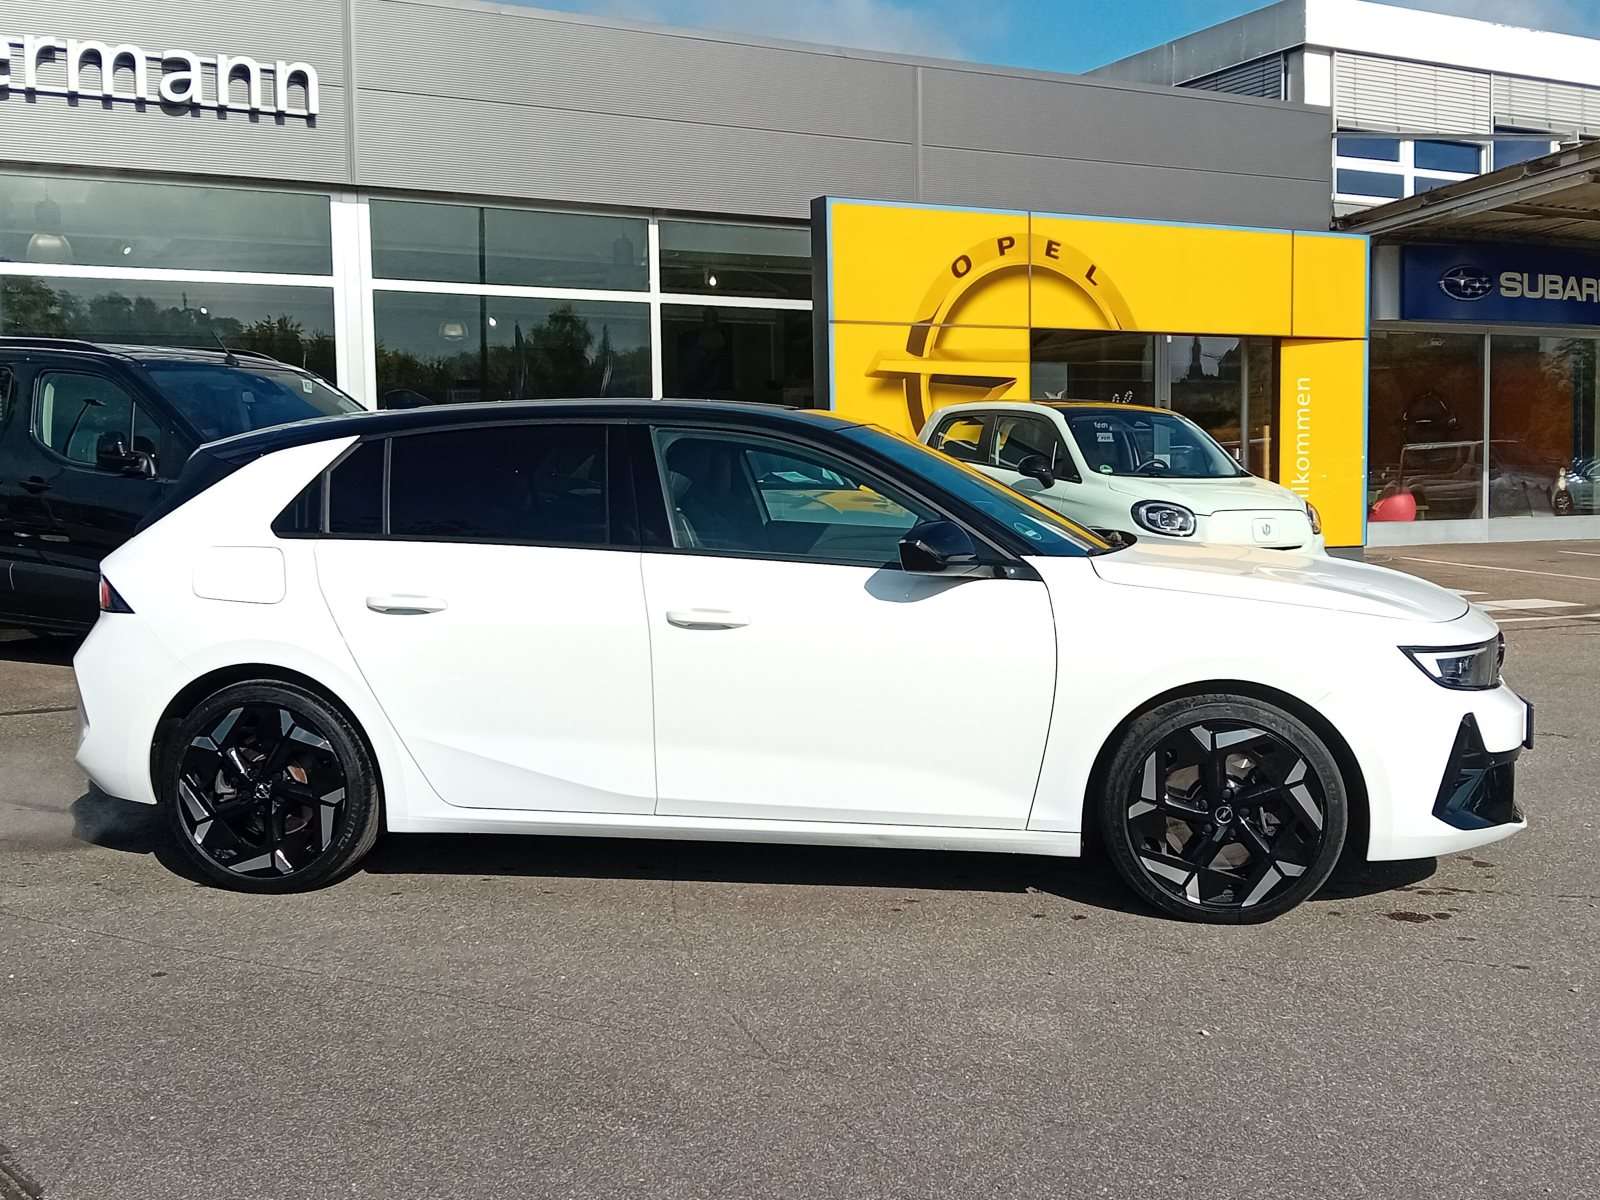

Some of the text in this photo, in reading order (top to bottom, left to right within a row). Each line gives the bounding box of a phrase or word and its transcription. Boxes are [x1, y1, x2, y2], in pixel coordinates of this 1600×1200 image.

[0, 34, 319, 115] rmann
[950, 236, 1099, 287] OPEL
[1499, 271, 1600, 304] SUBAR
